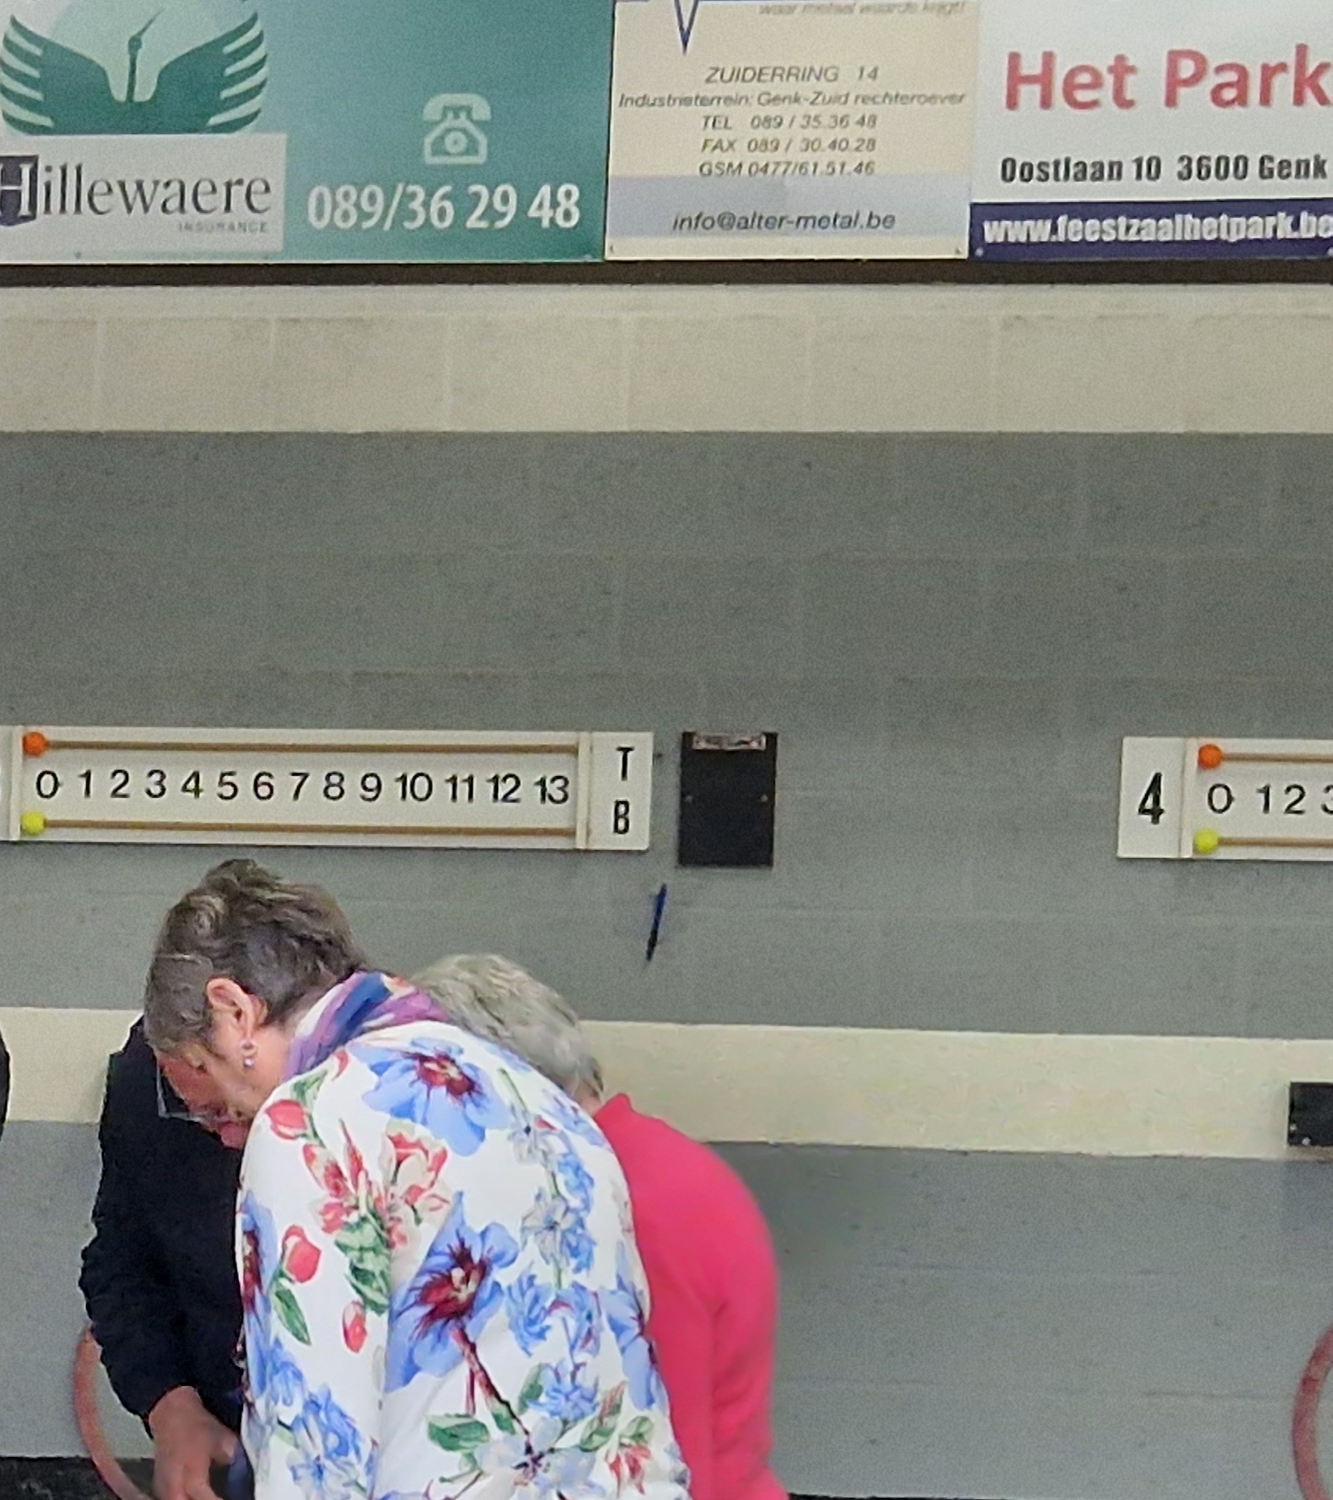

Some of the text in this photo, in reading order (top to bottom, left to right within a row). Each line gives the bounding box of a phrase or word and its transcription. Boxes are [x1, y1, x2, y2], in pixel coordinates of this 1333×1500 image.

[705, 66, 879, 83] ZUIDERRING 14
[1006, 42, 1332, 110] Het Park
[702, 115, 732, 130] TEL
[751, 115, 783, 129] 089
[701, 138, 737, 153] FAX
[747, 138, 780, 153] 089
[699, 161, 742, 177] GSM
[1001, 153, 1327, 182] Oostlaan 10 3600 Genk
[307, 183, 580, 231] 089/36 29 48
[672, 211, 896, 232] info@alter-metal.be
[983, 211, 1333, 243] www.feestzaalhetpark.be
[616, 746, 634, 781] T
[36, 769, 570, 805] 0 1 2 3 4 5 6 7 8 9 10 11 12 13
[1138, 772, 1165, 825] 4
[1206, 784, 1233, 814] 0
[1256, 784, 1271, 814] 1
[1284, 784, 1307, 815] 2
[613, 801, 630, 835] B
